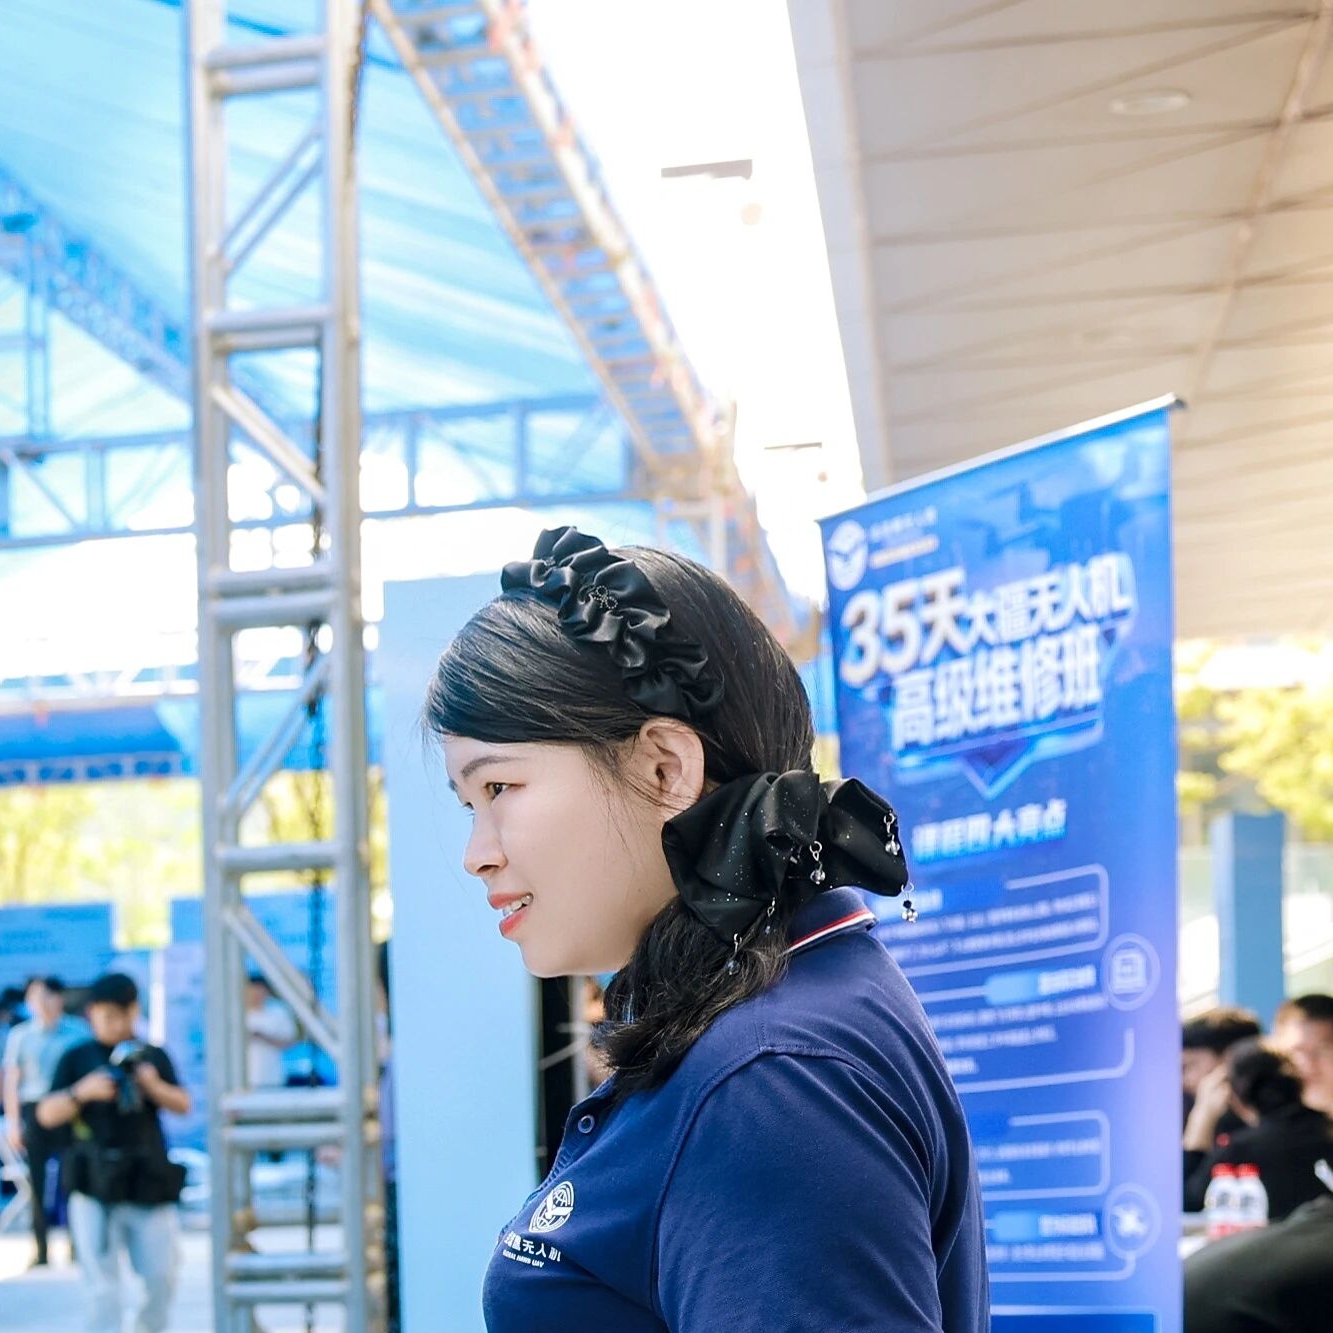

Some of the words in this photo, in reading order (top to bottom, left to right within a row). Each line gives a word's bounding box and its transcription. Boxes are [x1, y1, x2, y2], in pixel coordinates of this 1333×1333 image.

[891, 625, 1104, 752] 高级维修班
